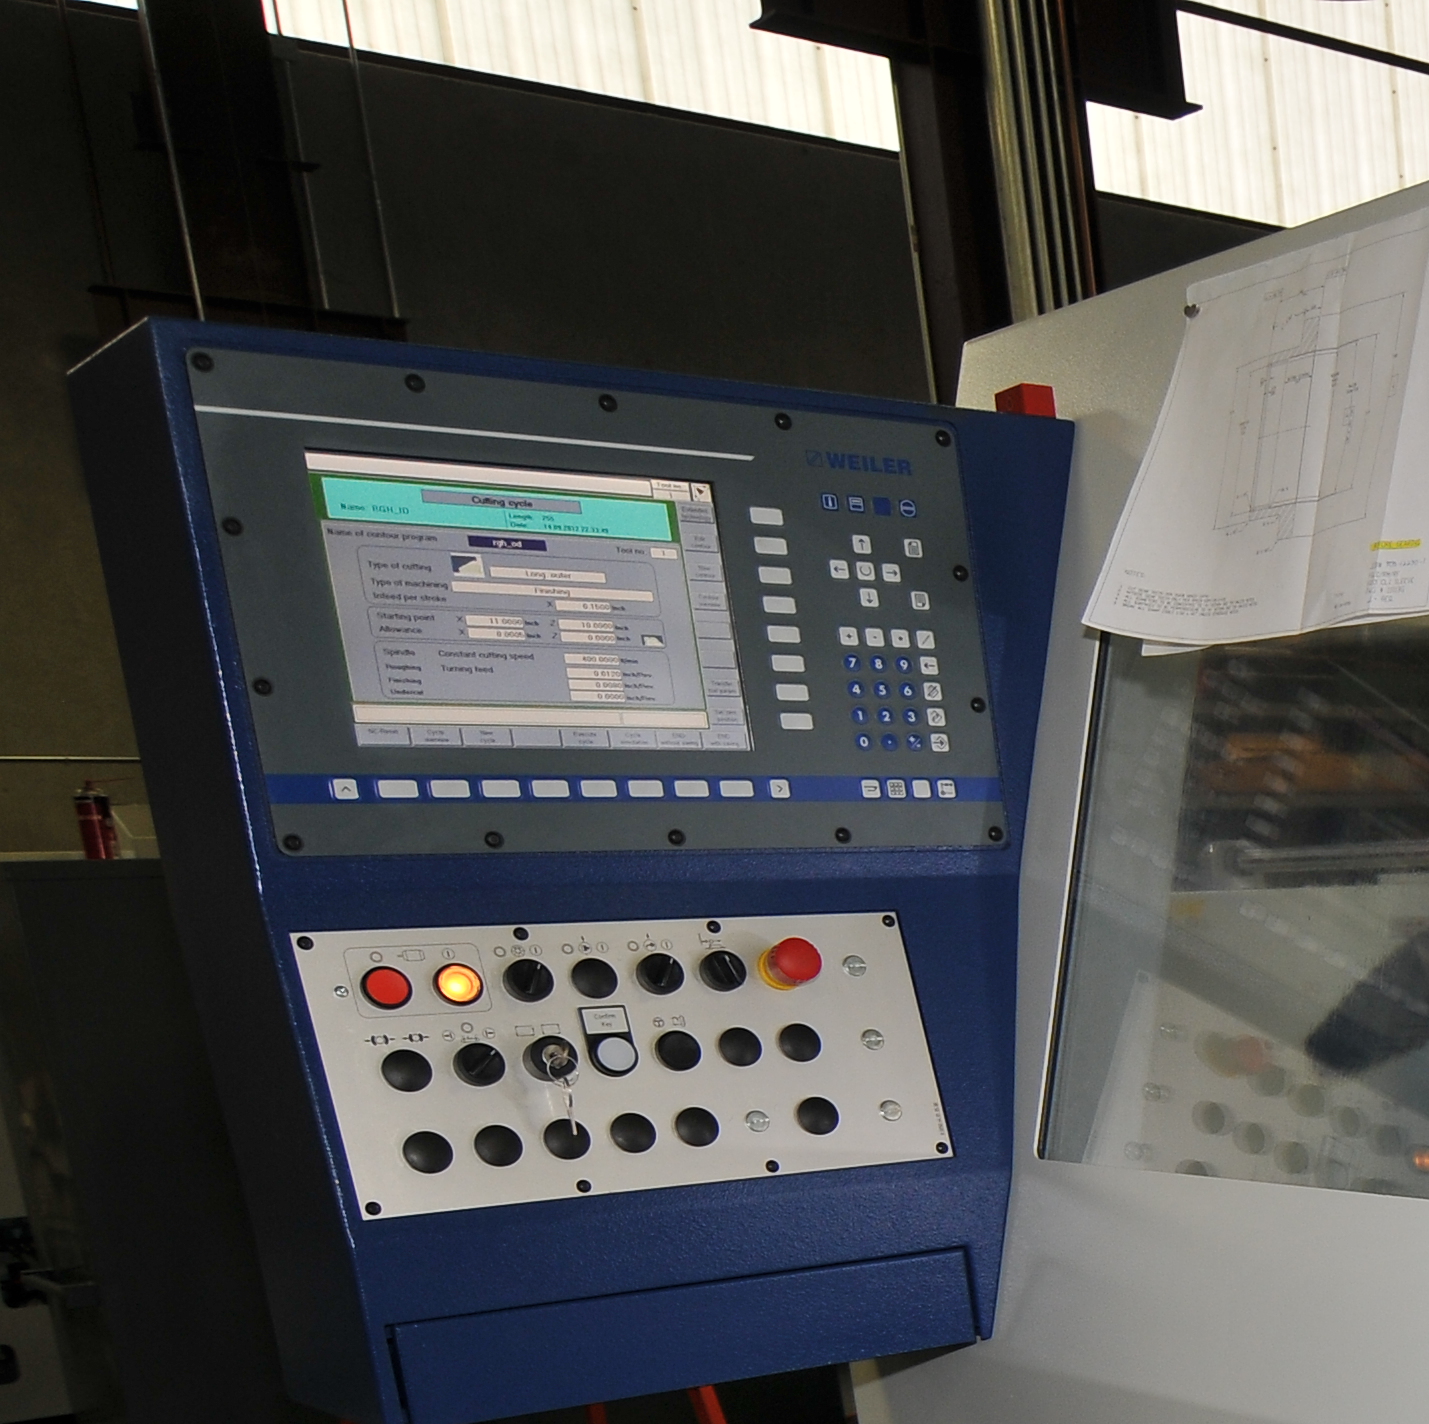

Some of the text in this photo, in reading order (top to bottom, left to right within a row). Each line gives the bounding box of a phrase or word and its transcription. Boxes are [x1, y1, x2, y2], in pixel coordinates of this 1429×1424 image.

[826, 451, 912, 476] WEILER
[472, 495, 533, 510] Cutting cycle
[848, 657, 909, 670] 7 8 9
[852, 684, 912, 696] 4 5 6
[882, 711, 891, 721] 2
[907, 711, 916, 722] 3
[859, 736, 869, 747] 0
